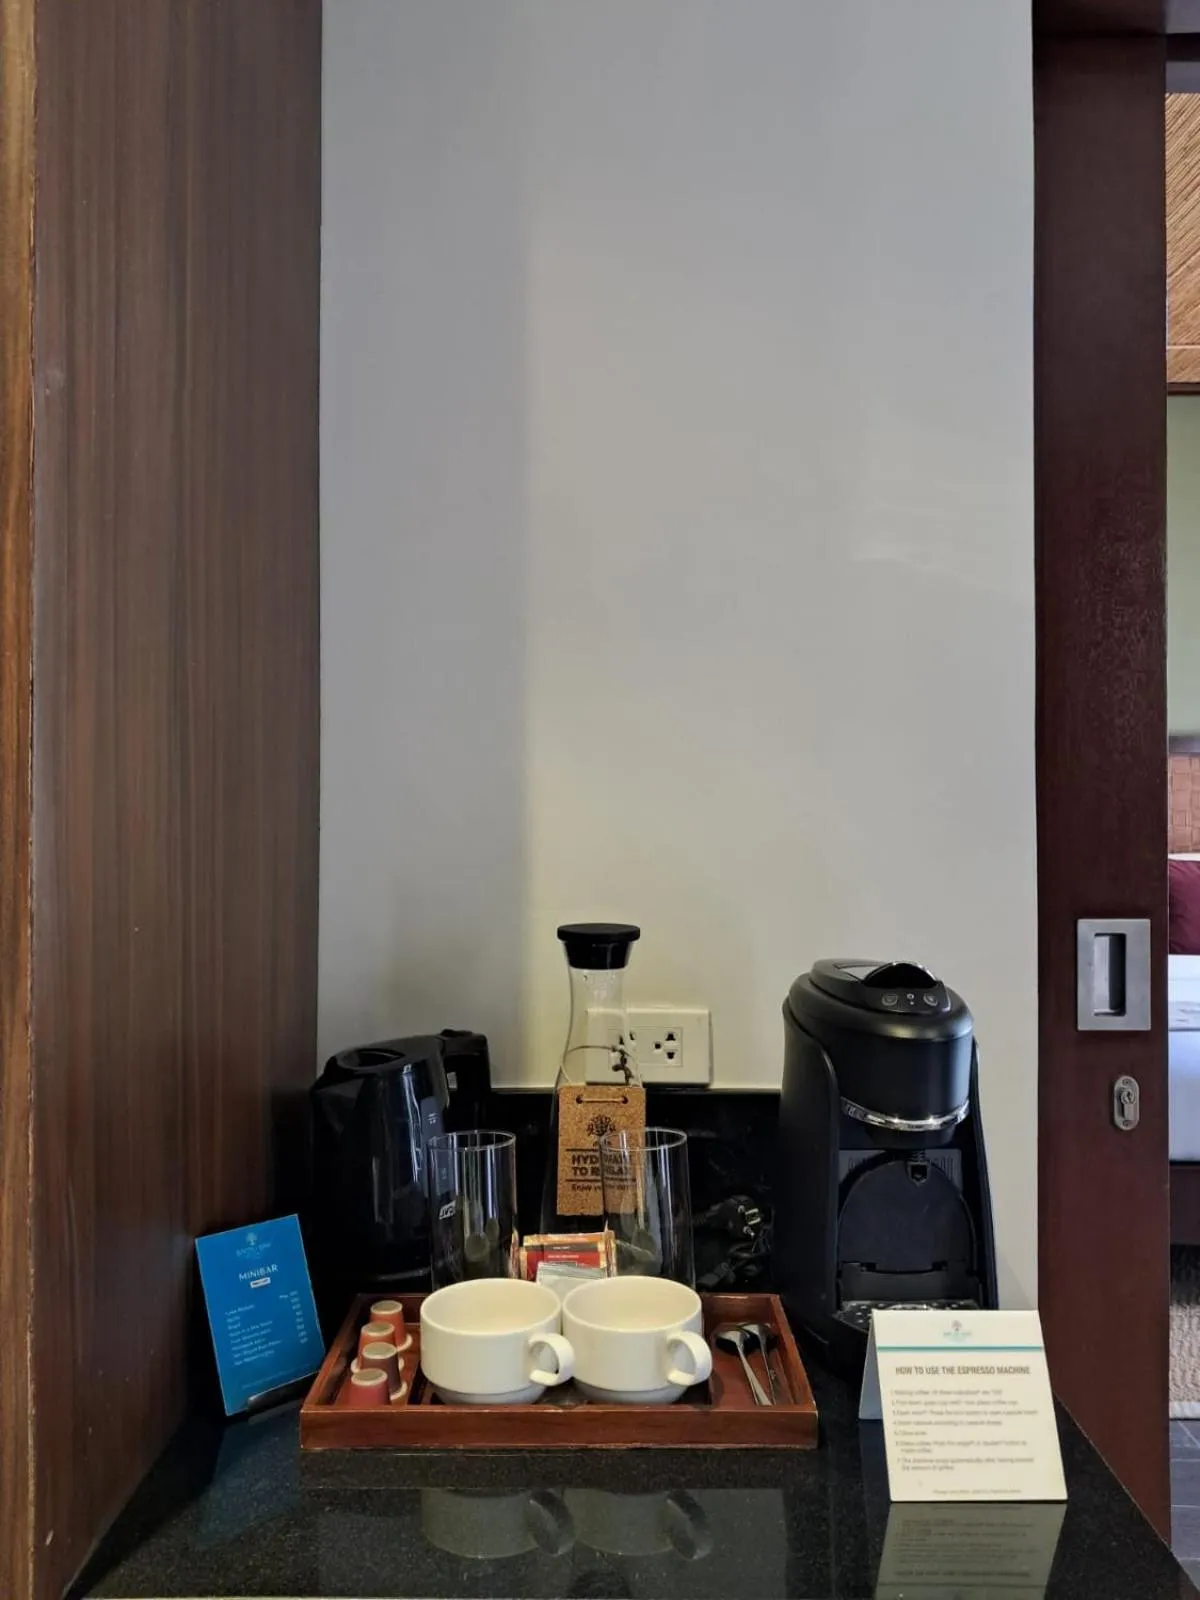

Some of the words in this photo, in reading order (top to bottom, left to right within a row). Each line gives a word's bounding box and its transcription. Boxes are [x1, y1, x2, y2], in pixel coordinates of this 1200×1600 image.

[572, 1166, 588, 1176] TO
[238, 1264, 279, 1281] MINIBAR
[895, 1366, 912, 1375] HOW
[915, 1366, 924, 1375] TO
[926, 1366, 939, 1375] USE
[942, 1366, 955, 1375] THE
[957, 1366, 995, 1375] ESPRESSO
[997, 1366, 1031, 1375] MACHINE
